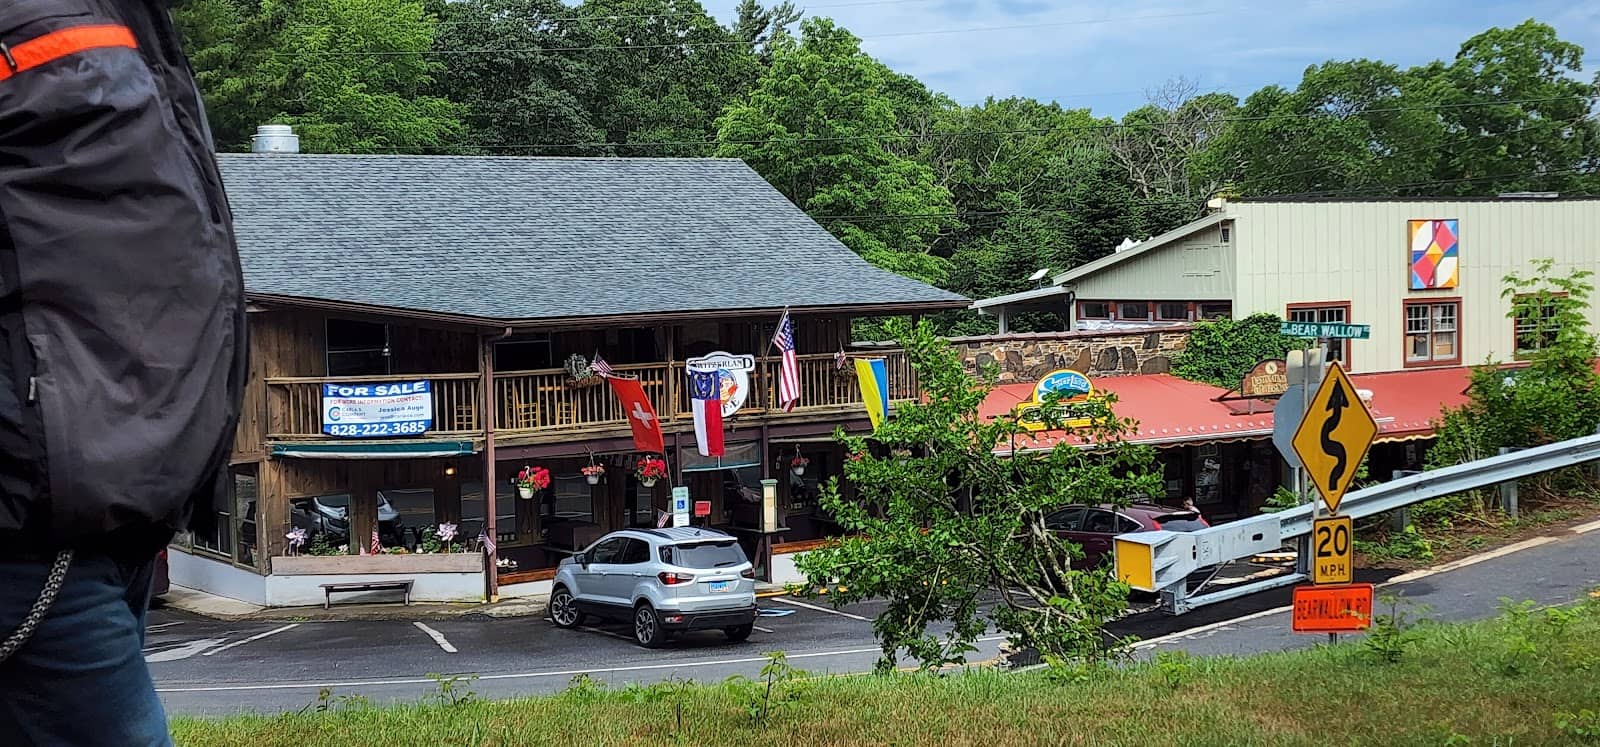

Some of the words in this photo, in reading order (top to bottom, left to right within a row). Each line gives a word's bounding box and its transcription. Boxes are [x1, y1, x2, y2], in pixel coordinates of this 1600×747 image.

[1291, 323, 1317, 336] BEAR
[1321, 325, 1362, 337] WALLOW
[327, 385, 369, 396] FOR
[375, 381, 426, 396] SALE
[330, 421, 426, 436] 828-222-3685
[1317, 524, 1349, 558] 20
